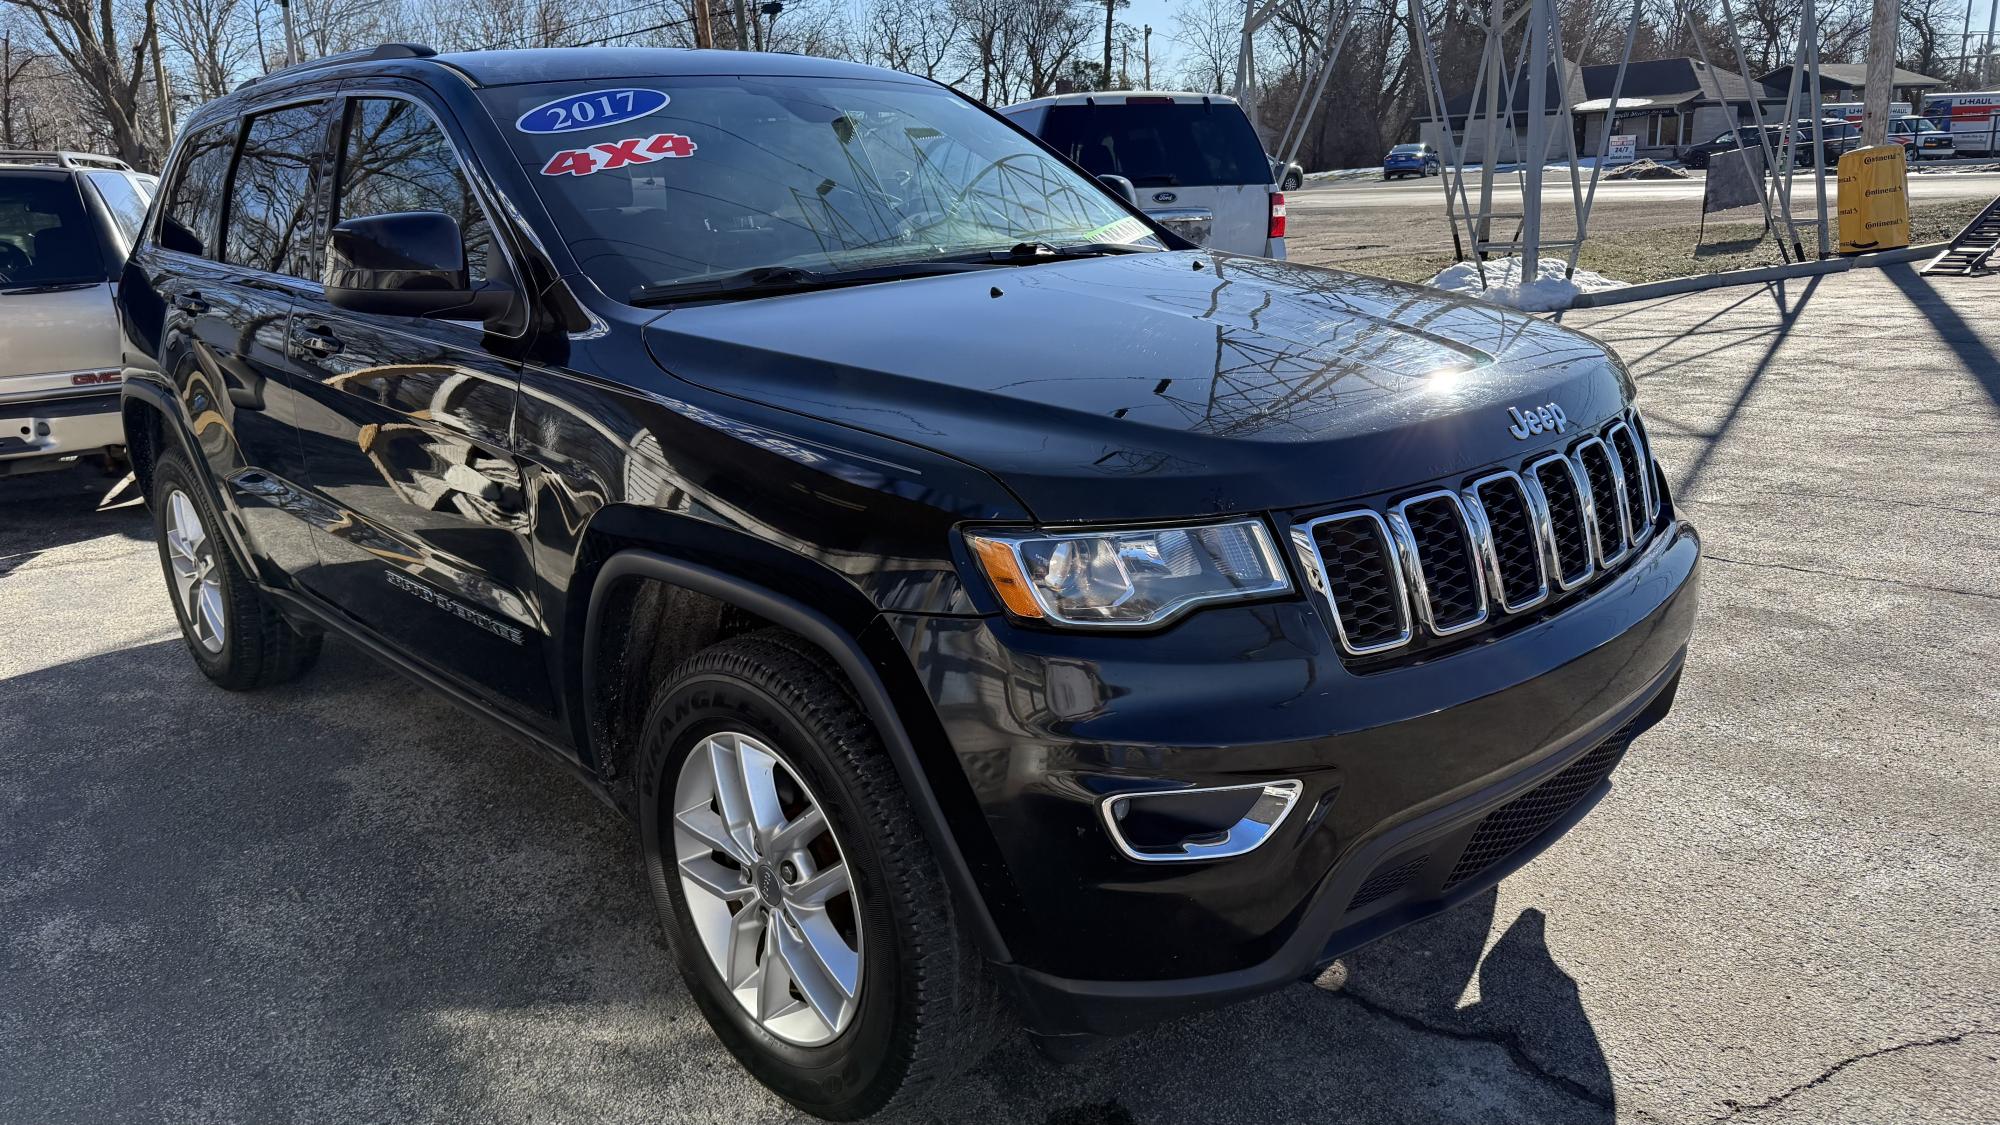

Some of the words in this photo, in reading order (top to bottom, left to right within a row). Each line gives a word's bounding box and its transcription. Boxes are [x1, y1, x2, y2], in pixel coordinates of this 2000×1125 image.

[546, 91, 635, 130] 2017
[72, 371, 121, 386] GMC
[1506, 402, 1567, 440] Jeep
